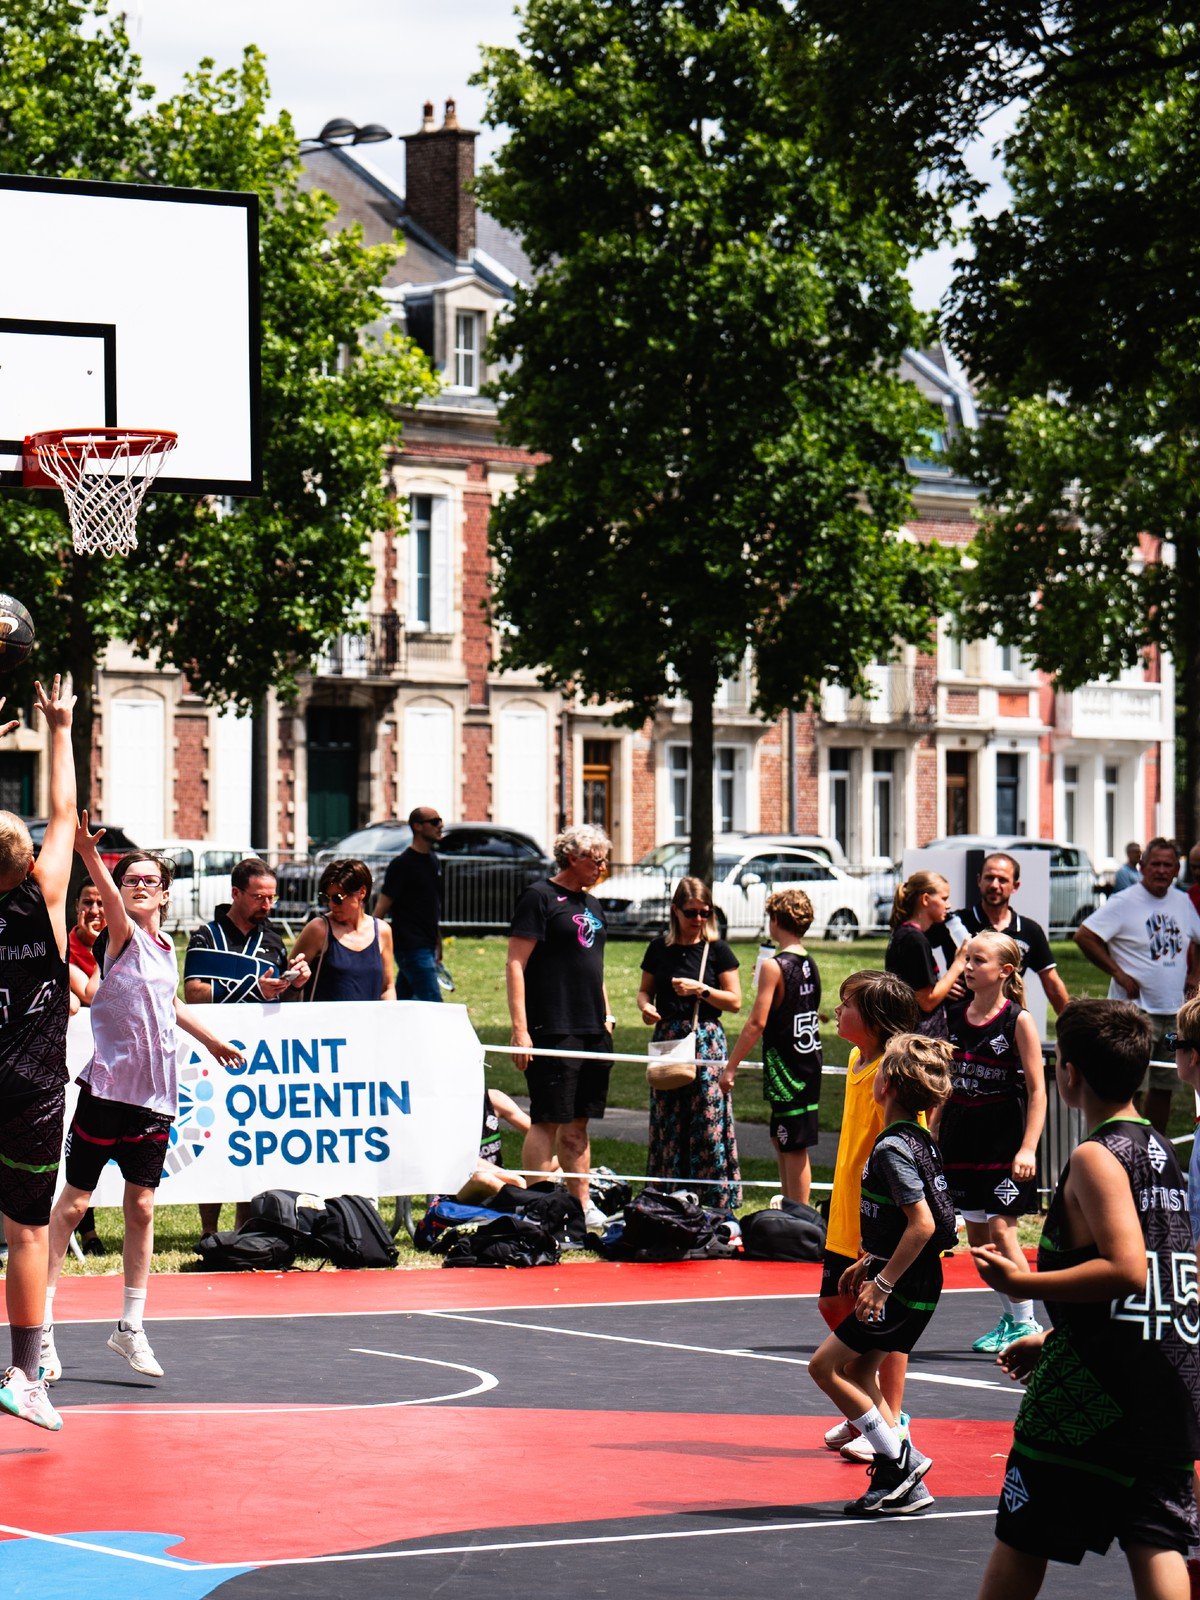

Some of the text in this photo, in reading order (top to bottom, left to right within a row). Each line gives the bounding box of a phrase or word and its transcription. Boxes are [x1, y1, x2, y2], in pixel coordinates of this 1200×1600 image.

[224, 1038, 347, 1076] SAINT
[225, 1081, 412, 1126] QUENTIN
[228, 1126, 391, 1167] SPORTS
[1110, 1251, 1200, 1345] 45
